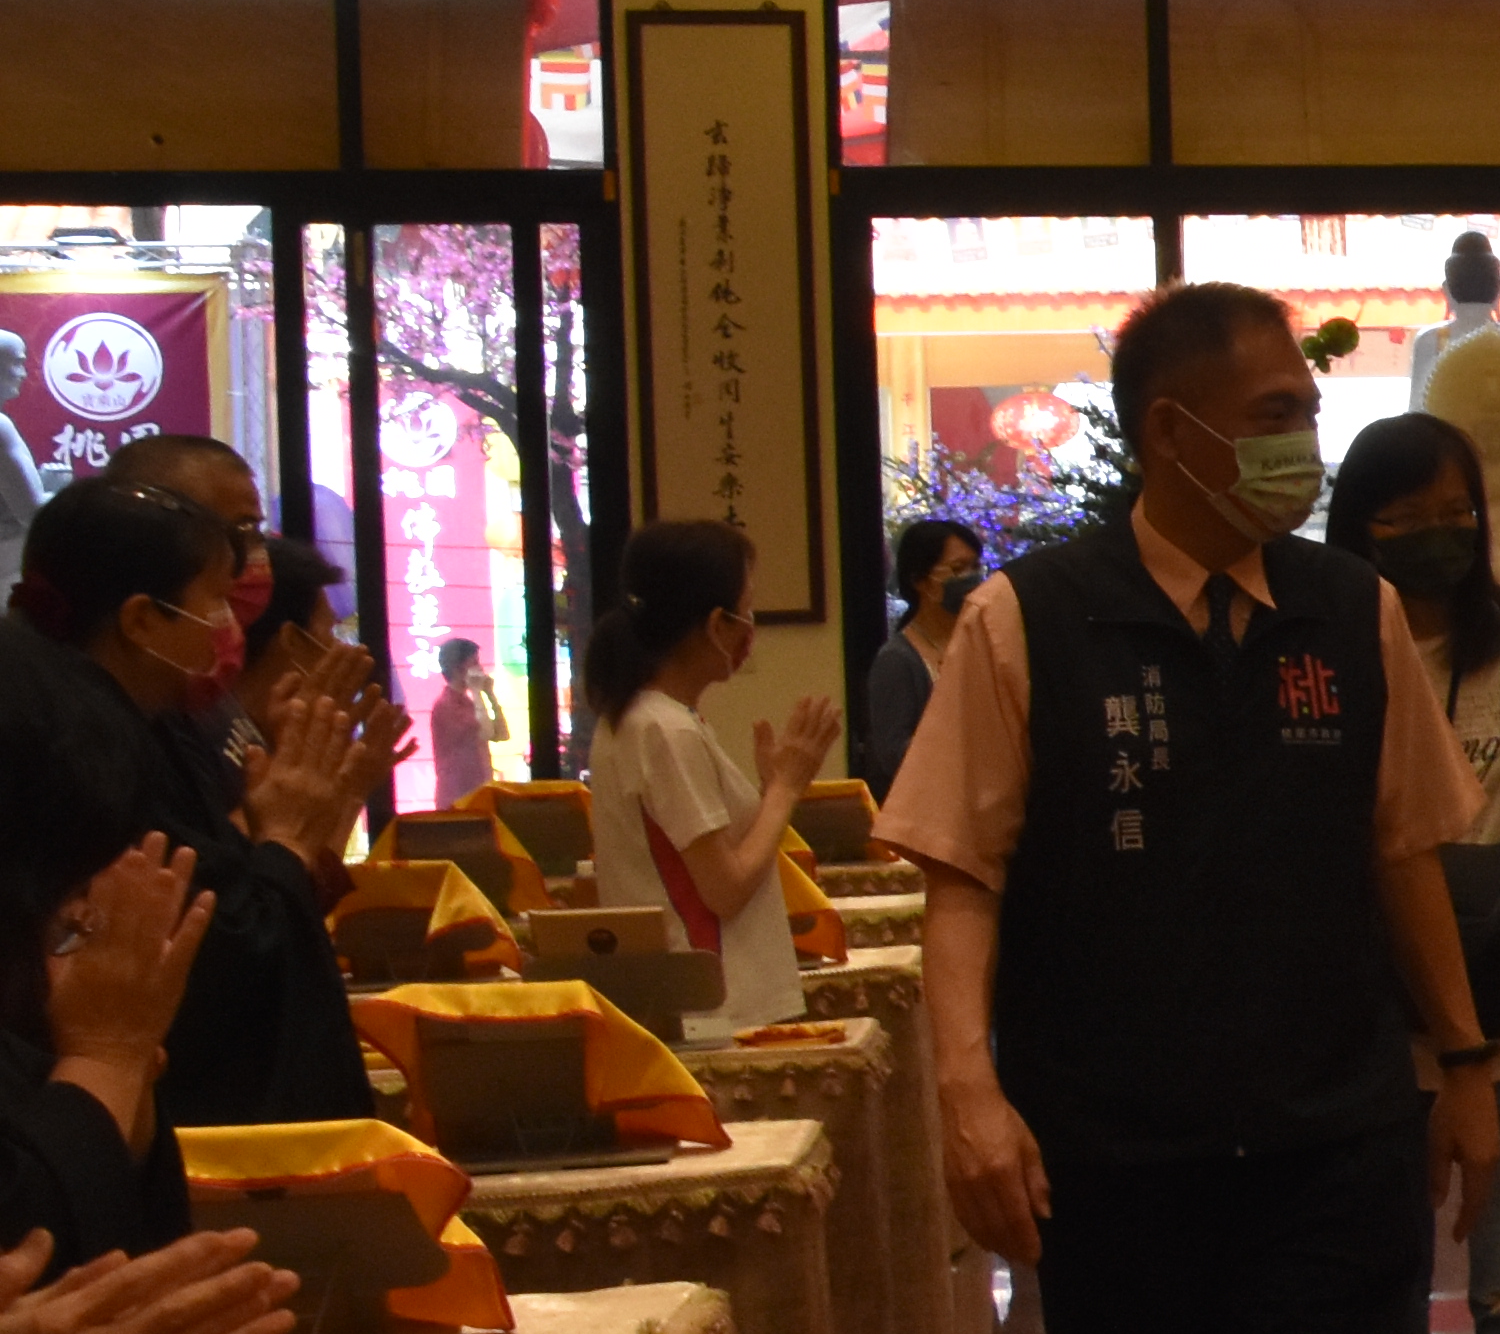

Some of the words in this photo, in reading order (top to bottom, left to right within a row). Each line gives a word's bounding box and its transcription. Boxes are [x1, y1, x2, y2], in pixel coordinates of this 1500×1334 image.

[1103, 693, 1146, 851] 龔永信
[1141, 664, 1171, 772] 消防局長
